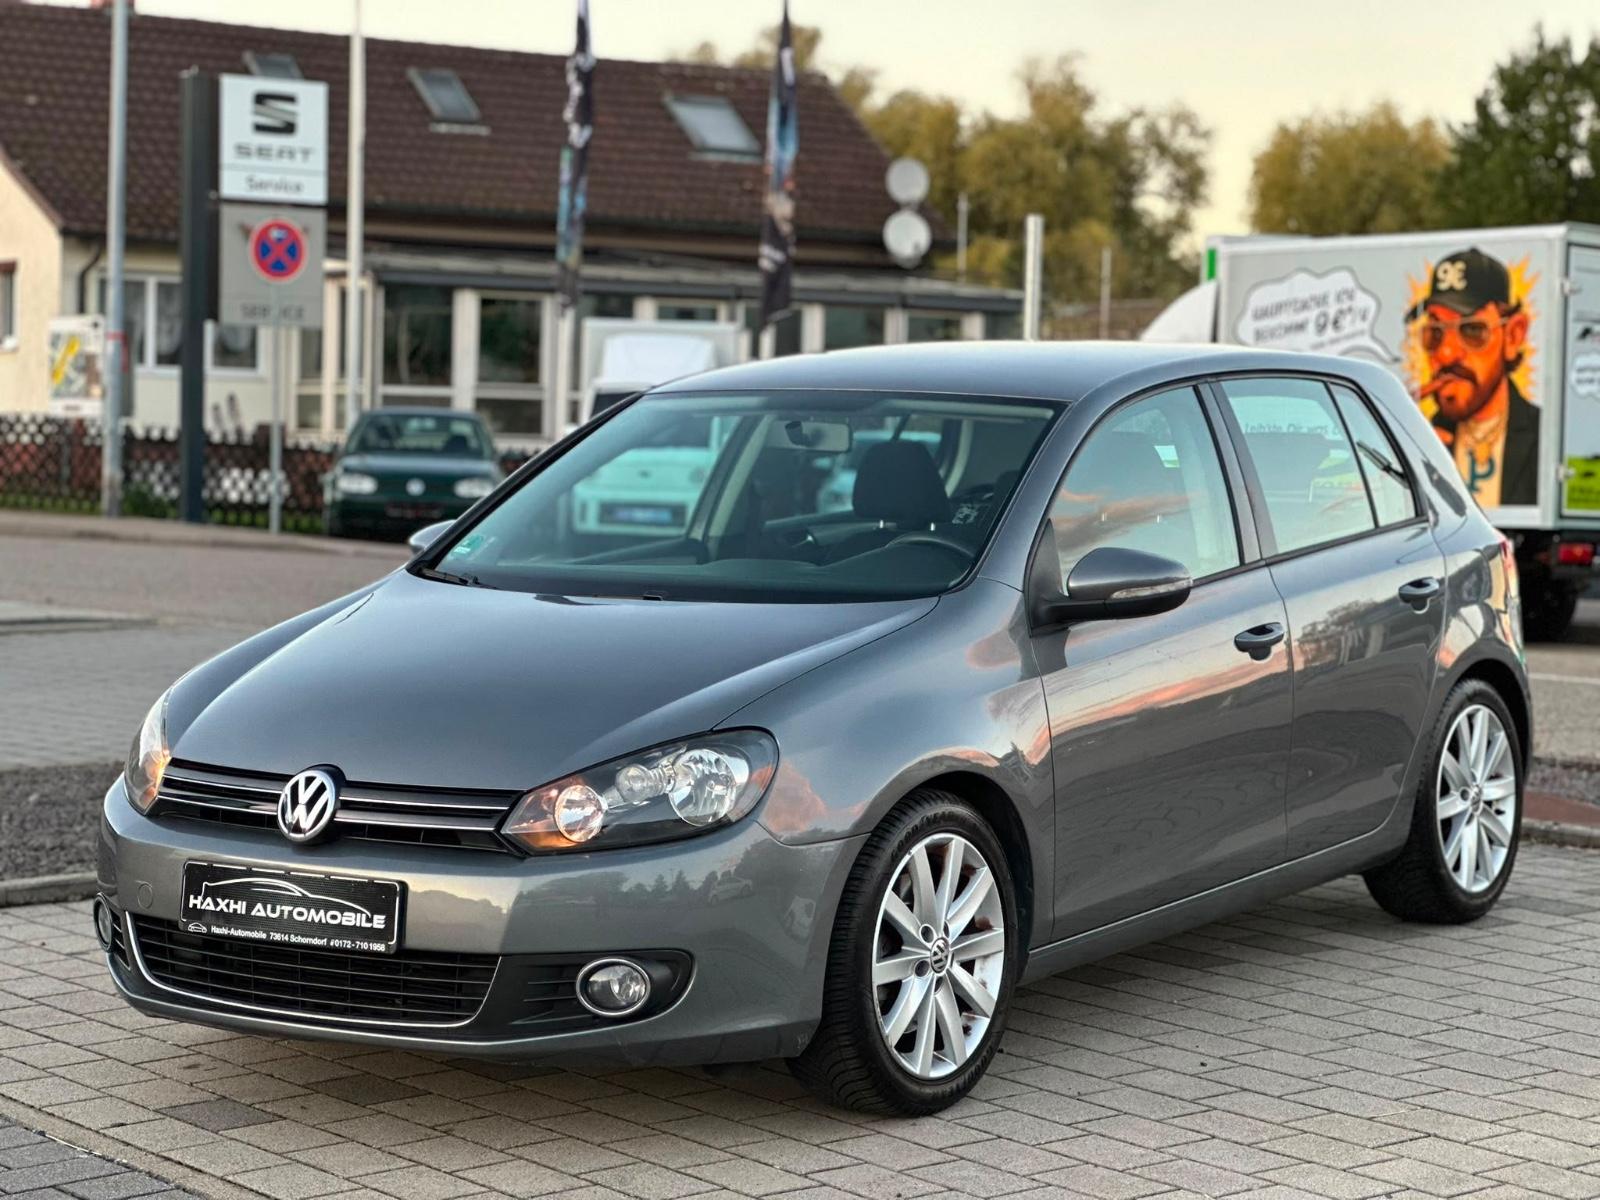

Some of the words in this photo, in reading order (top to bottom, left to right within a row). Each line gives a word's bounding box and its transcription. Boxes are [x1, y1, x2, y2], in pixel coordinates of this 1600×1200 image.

[234, 143, 314, 163] SEAT
[245, 175, 304, 194] Service
[241, 303, 305, 320] SERICE
[188, 894, 246, 914] HAXHI
[251, 902, 386, 929] AUTOMOBILE
[210, 925, 267, 939] Haxhi-Automobile
[289, 934, 327, 946] Schorndorf
